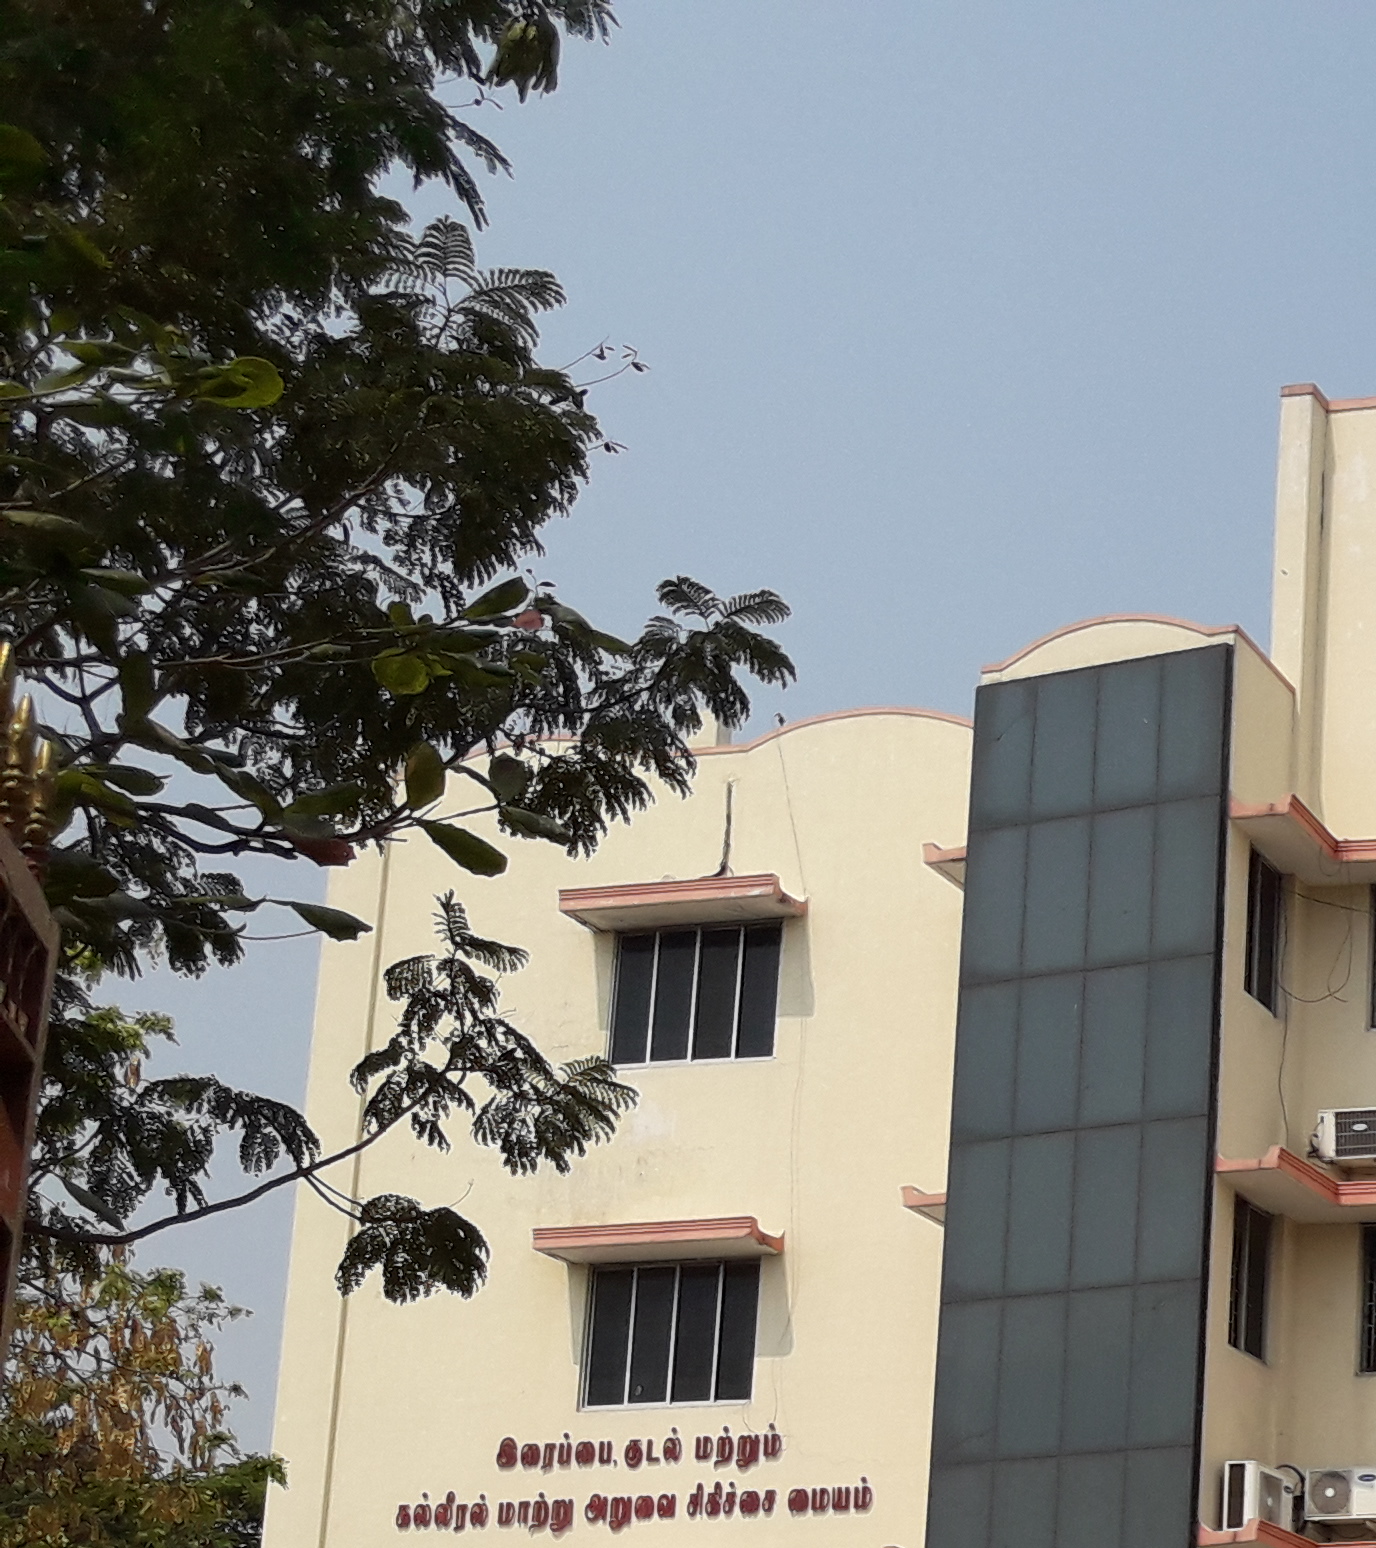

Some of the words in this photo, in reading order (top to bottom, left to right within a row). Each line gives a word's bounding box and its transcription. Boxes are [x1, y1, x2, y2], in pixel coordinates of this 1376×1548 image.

[496, 1432, 619, 1473] இரைப்பை,
[624, 1426, 683, 1468] குடல்
[694, 1422, 783, 1470] மற்றும்
[395, 1490, 489, 1532] கல்லீரல்
[497, 1491, 574, 1534] மாற்று
[584, 1492, 677, 1532] அறுவை
[686, 1481, 777, 1518] சிகிச்சை
[787, 1476, 873, 1513] மையம்
